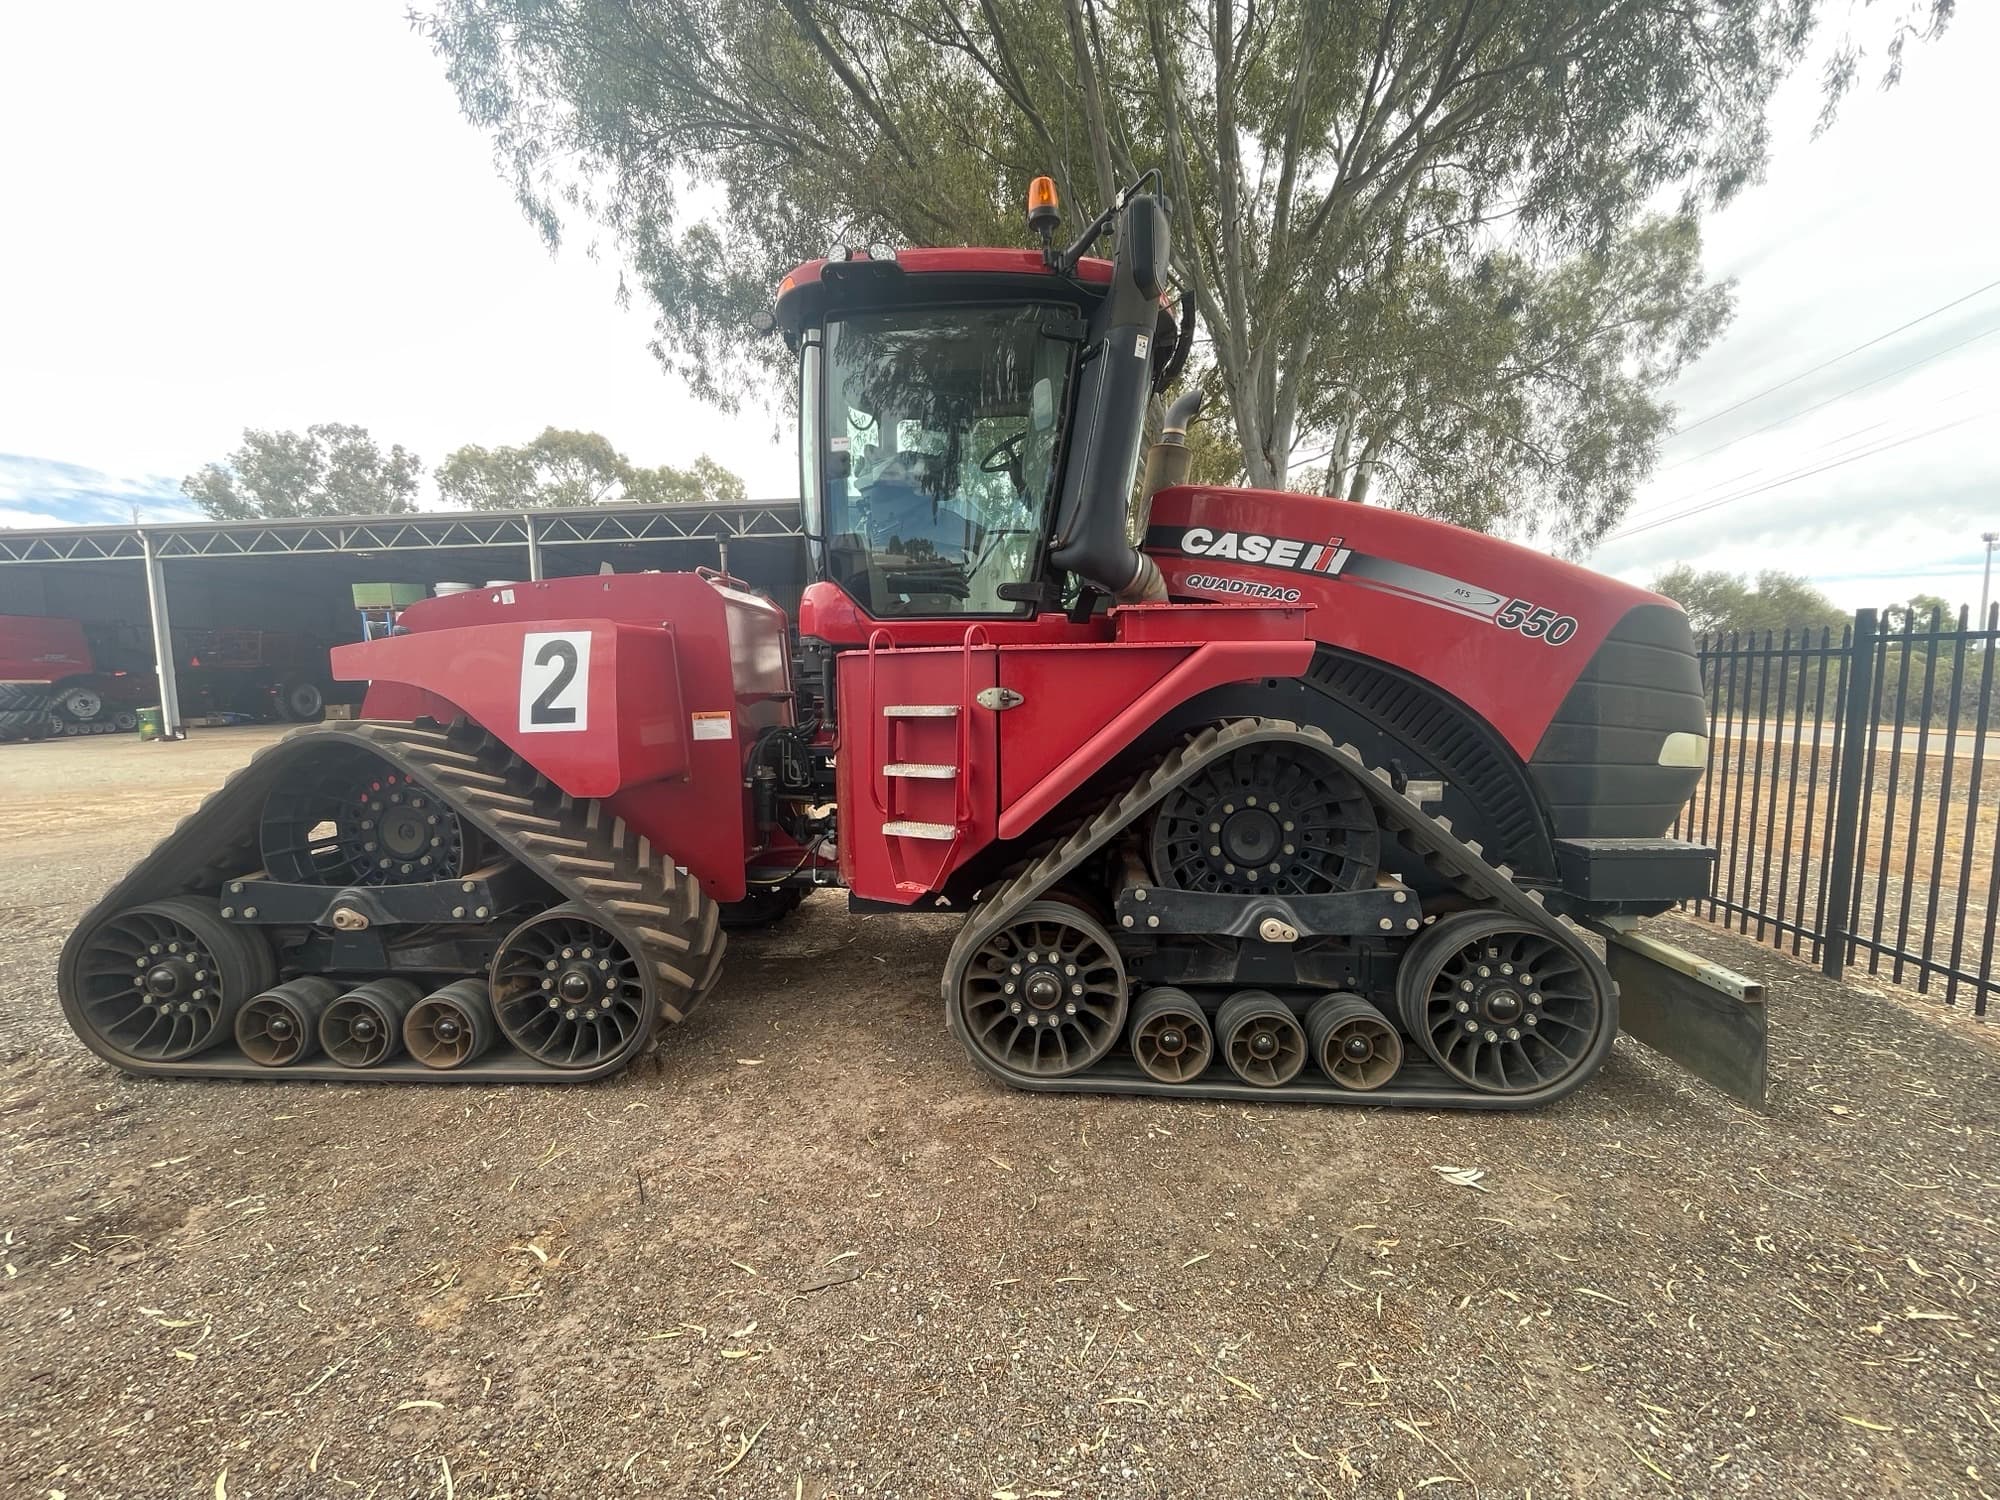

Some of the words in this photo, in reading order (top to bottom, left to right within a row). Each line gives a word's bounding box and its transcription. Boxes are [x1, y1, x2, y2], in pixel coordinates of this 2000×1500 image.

[1181, 528, 1304, 567] CASE
[1186, 574, 1302, 602] QUADTRAC
[1495, 598, 1578, 646] 550
[531, 639, 578, 724] 2
